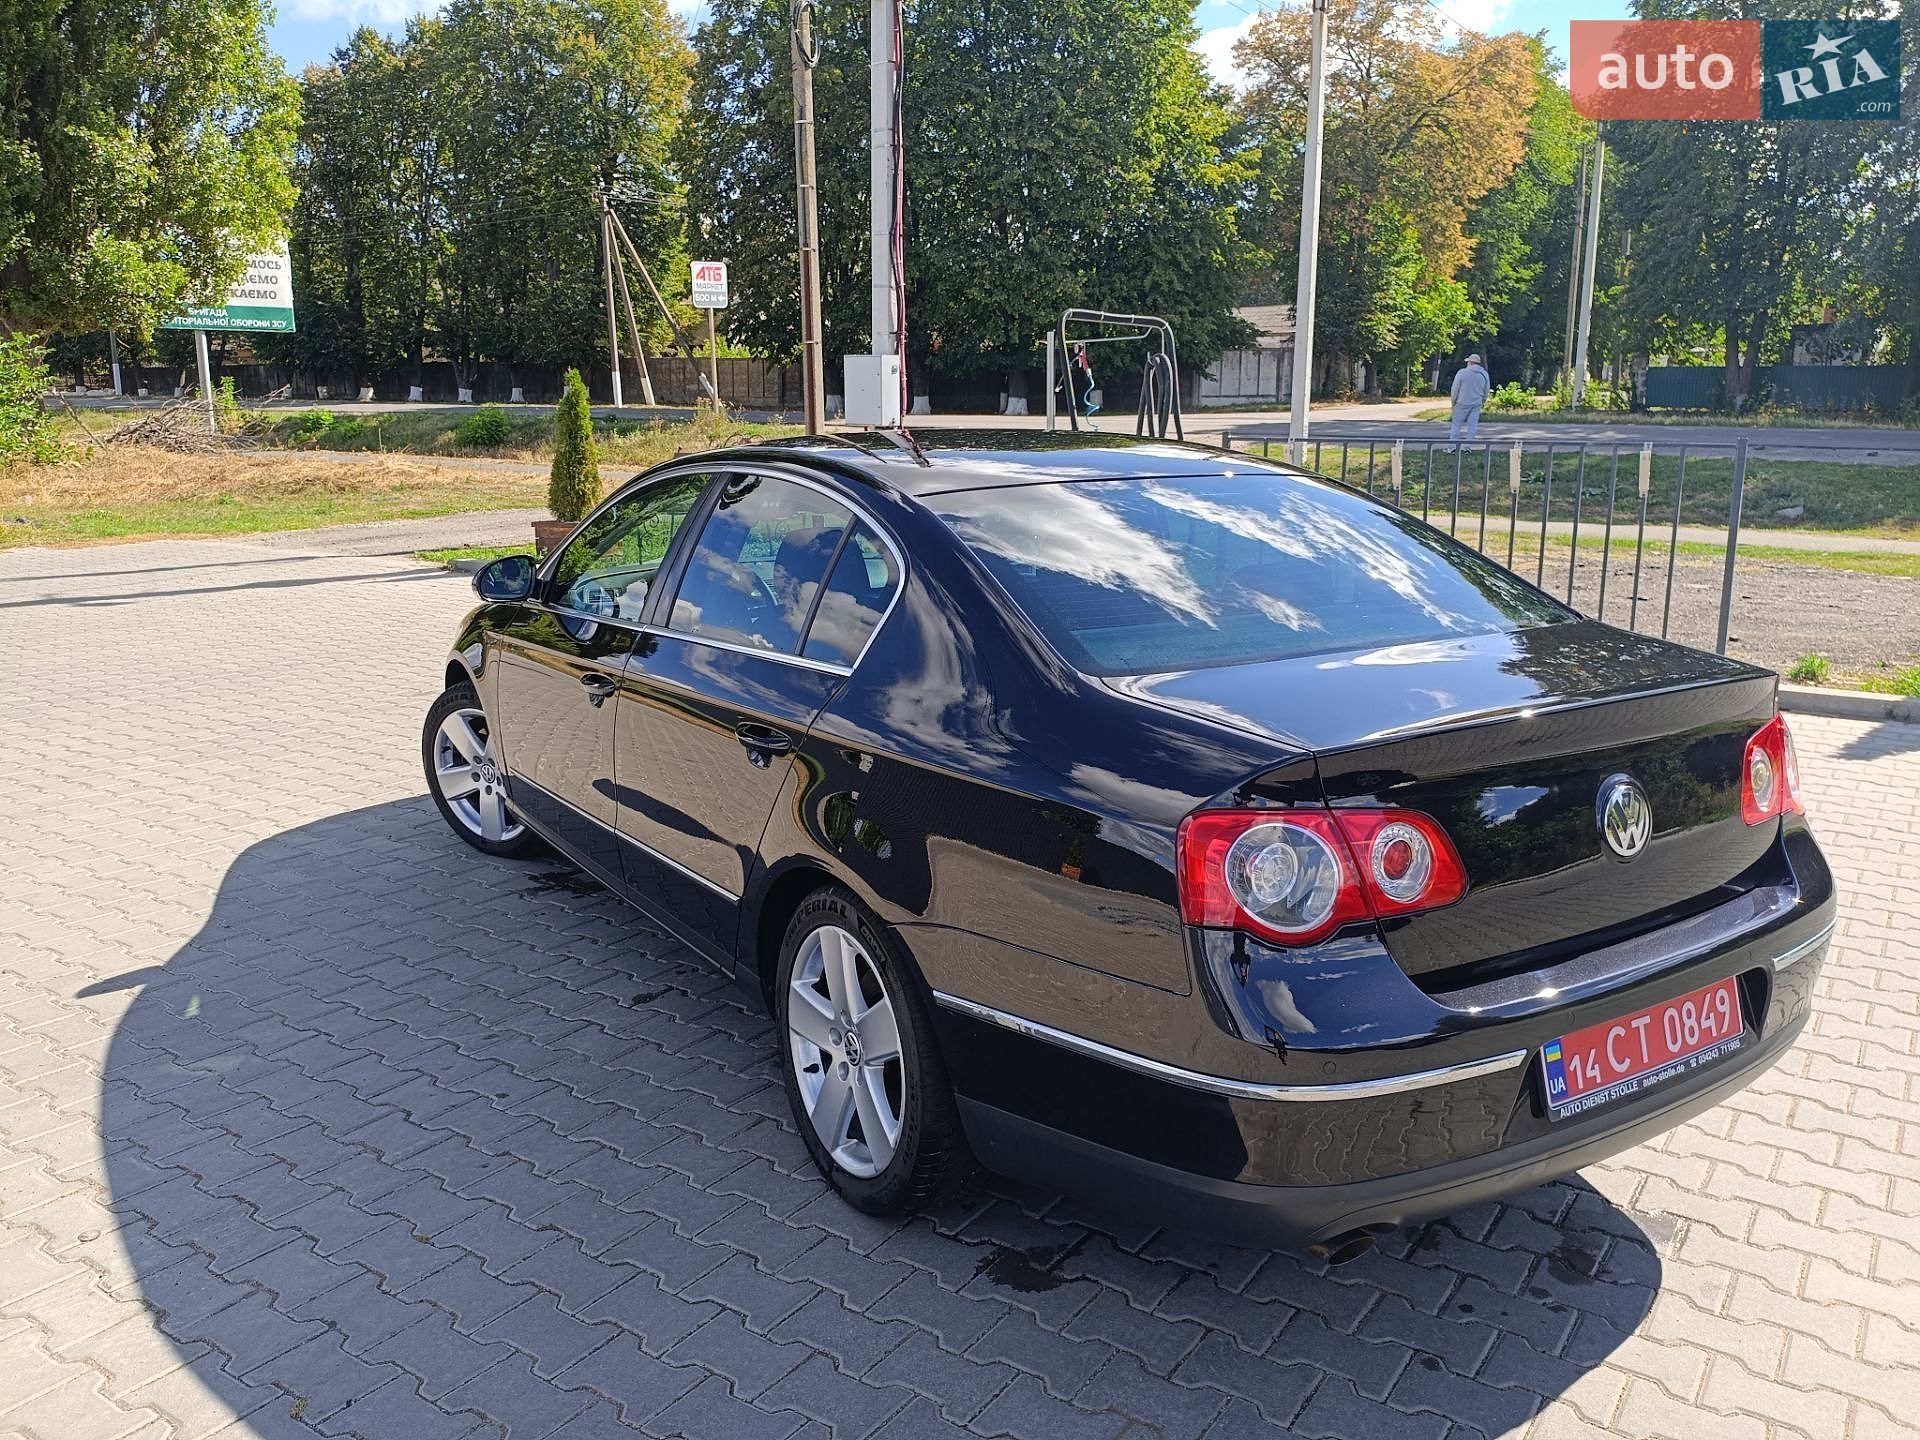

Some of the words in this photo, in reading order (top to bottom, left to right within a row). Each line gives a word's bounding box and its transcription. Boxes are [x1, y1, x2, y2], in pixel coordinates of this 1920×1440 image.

[241, 273, 278, 285] АЄМО
[696, 266, 722, 282] АТБ
[228, 288, 277, 300] КАЄМО
[695, 293, 710, 302] 500
[171, 316, 229, 327] ИТОРІАЛЬНОЇ
[231, 319, 271, 328] ОБОРОНИ
[1550, 1076, 1567, 1094] UA
[1569, 1048, 1601, 1090] 14
[1606, 1015, 1651, 1073] CT
[1663, 988, 1731, 1053] 0849
[1560, 1102, 1582, 1119] AUTO
[1582, 1091, 1610, 1111] DIENST
[1611, 1080, 1639, 1099] STOLLE
